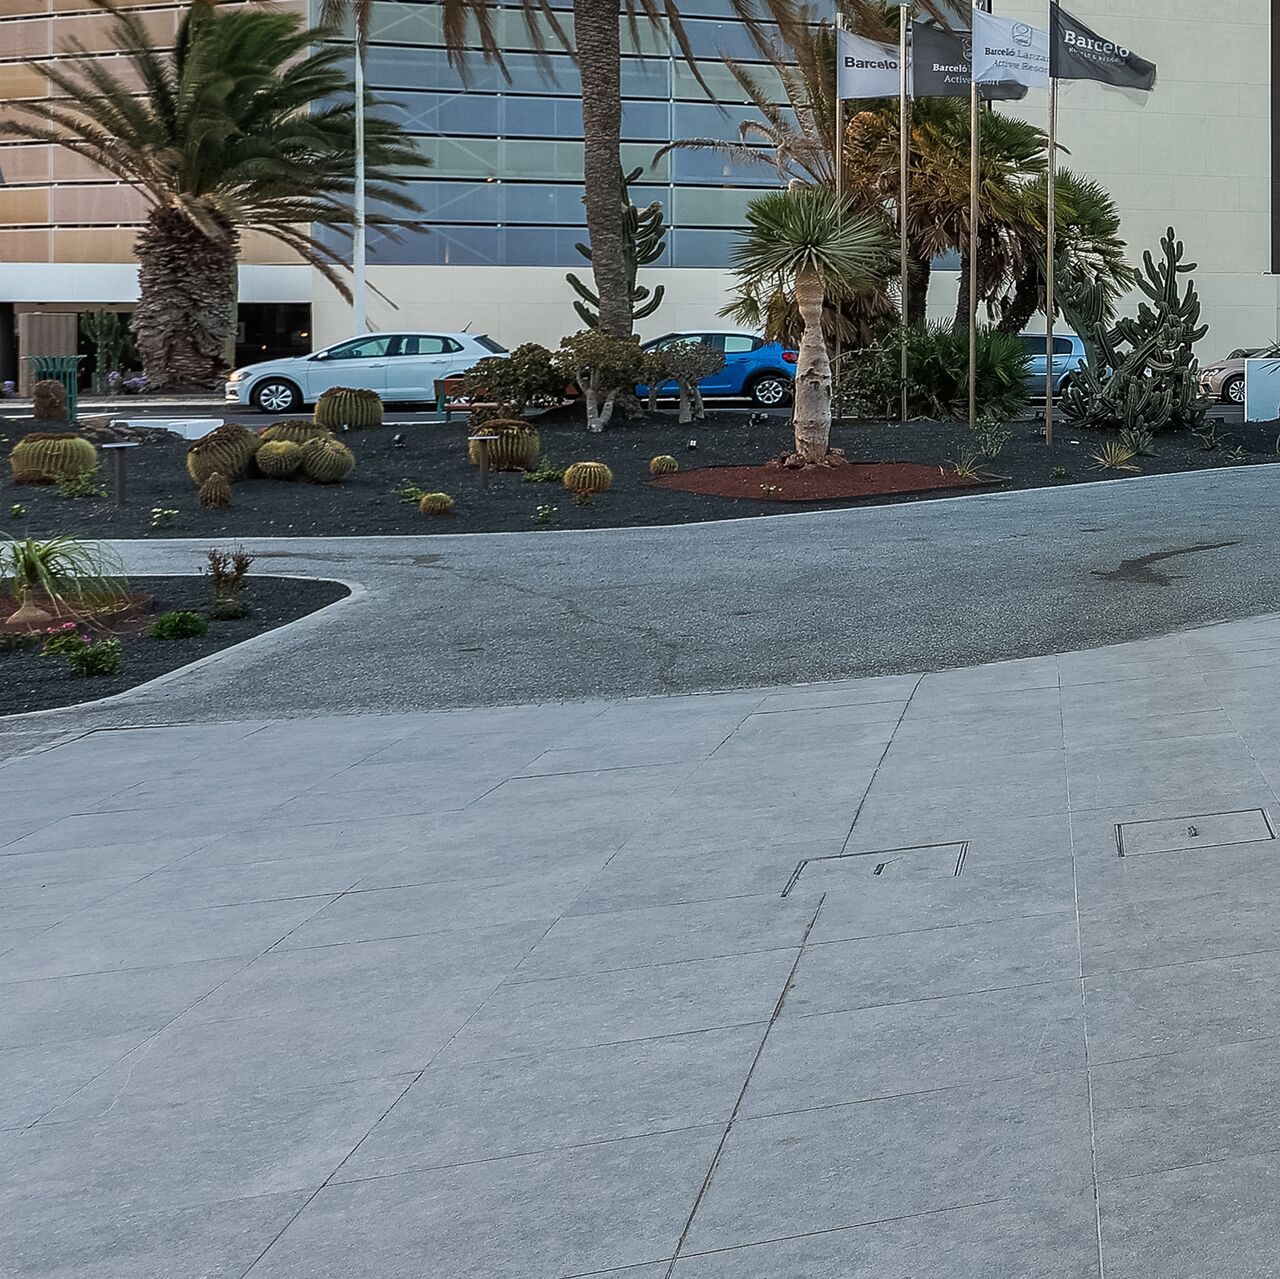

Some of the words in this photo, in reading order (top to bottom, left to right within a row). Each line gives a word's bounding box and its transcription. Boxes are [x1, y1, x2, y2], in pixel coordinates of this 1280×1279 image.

[985, 47, 1016, 57] Barceló
[932, 63, 968, 73] Barceló
[1022, 62, 1049, 73] Reso
